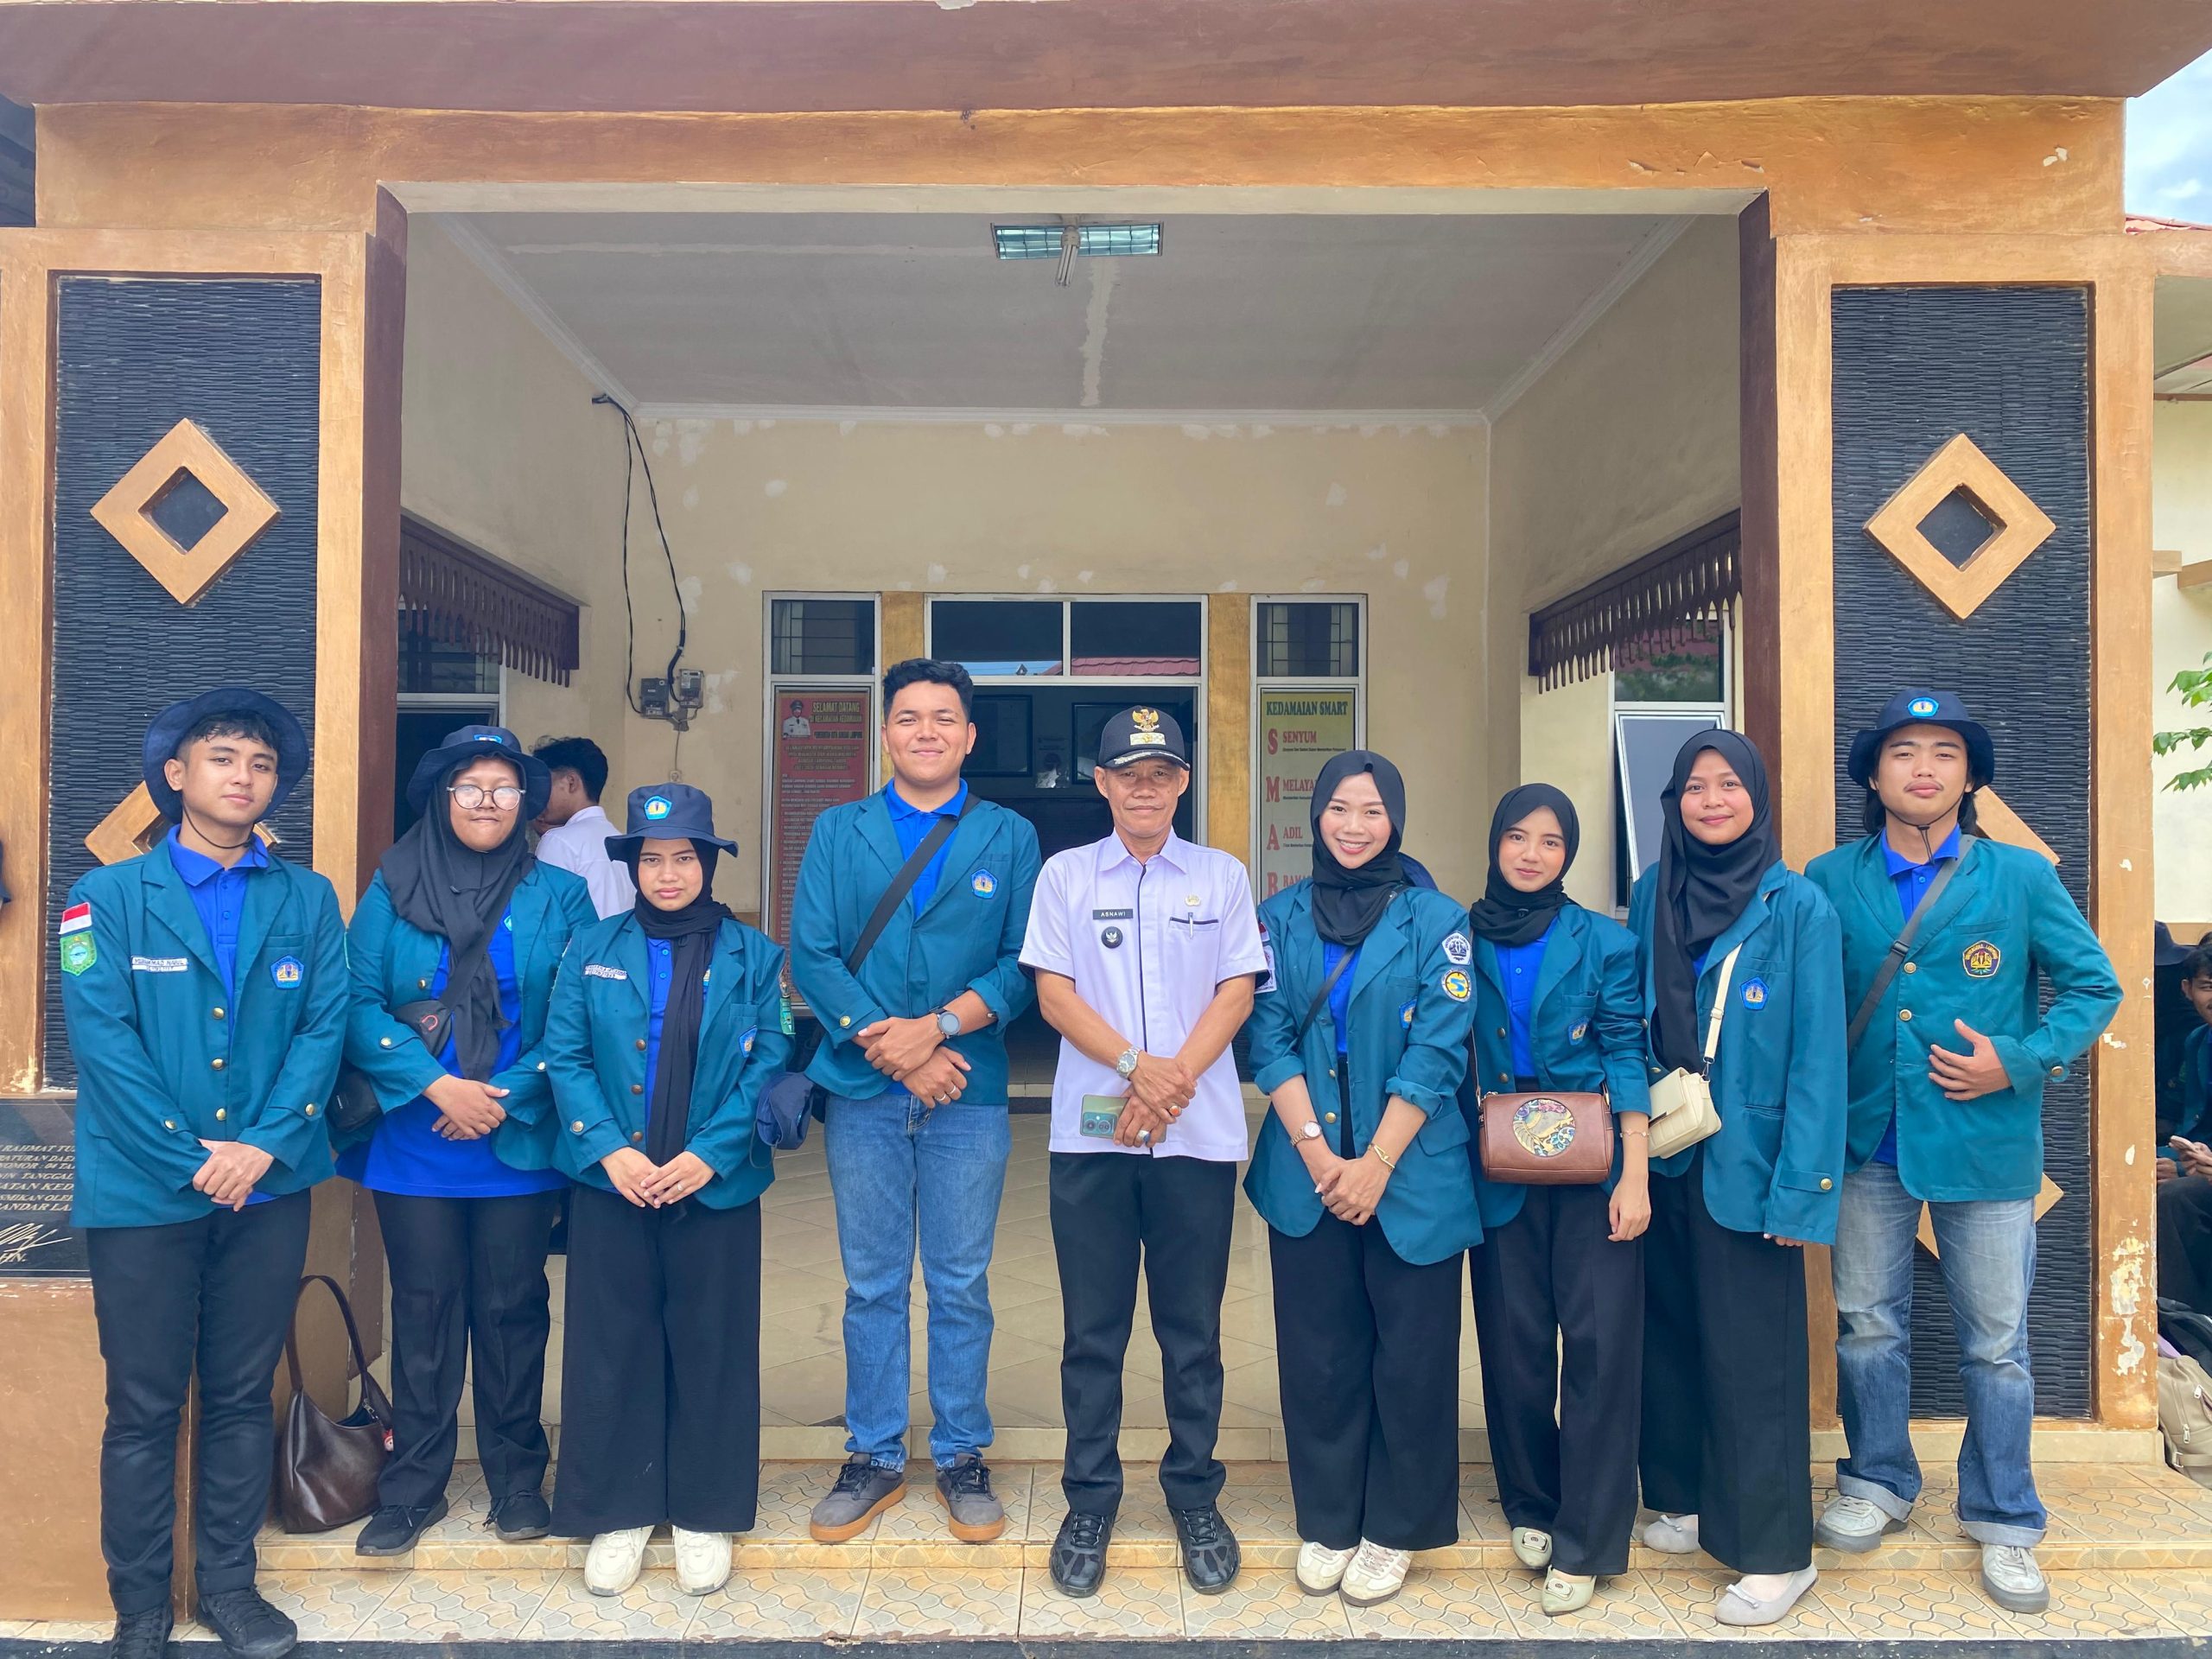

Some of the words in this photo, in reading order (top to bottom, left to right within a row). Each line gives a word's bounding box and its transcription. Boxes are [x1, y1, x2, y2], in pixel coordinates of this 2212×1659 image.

[813, 702, 838, 713] SELAMAT
[838, 702, 860, 713] DATANG
[1266, 701, 1318, 715] KEDAMAIAN
[1319, 701, 1348, 715] SMART
[1268, 728, 1278, 755] S
[1282, 731, 1317, 743] SENYUM
[1265, 776, 1280, 803] M
[1267, 823, 1280, 851] A
[1283, 826, 1303, 839] ADIL
